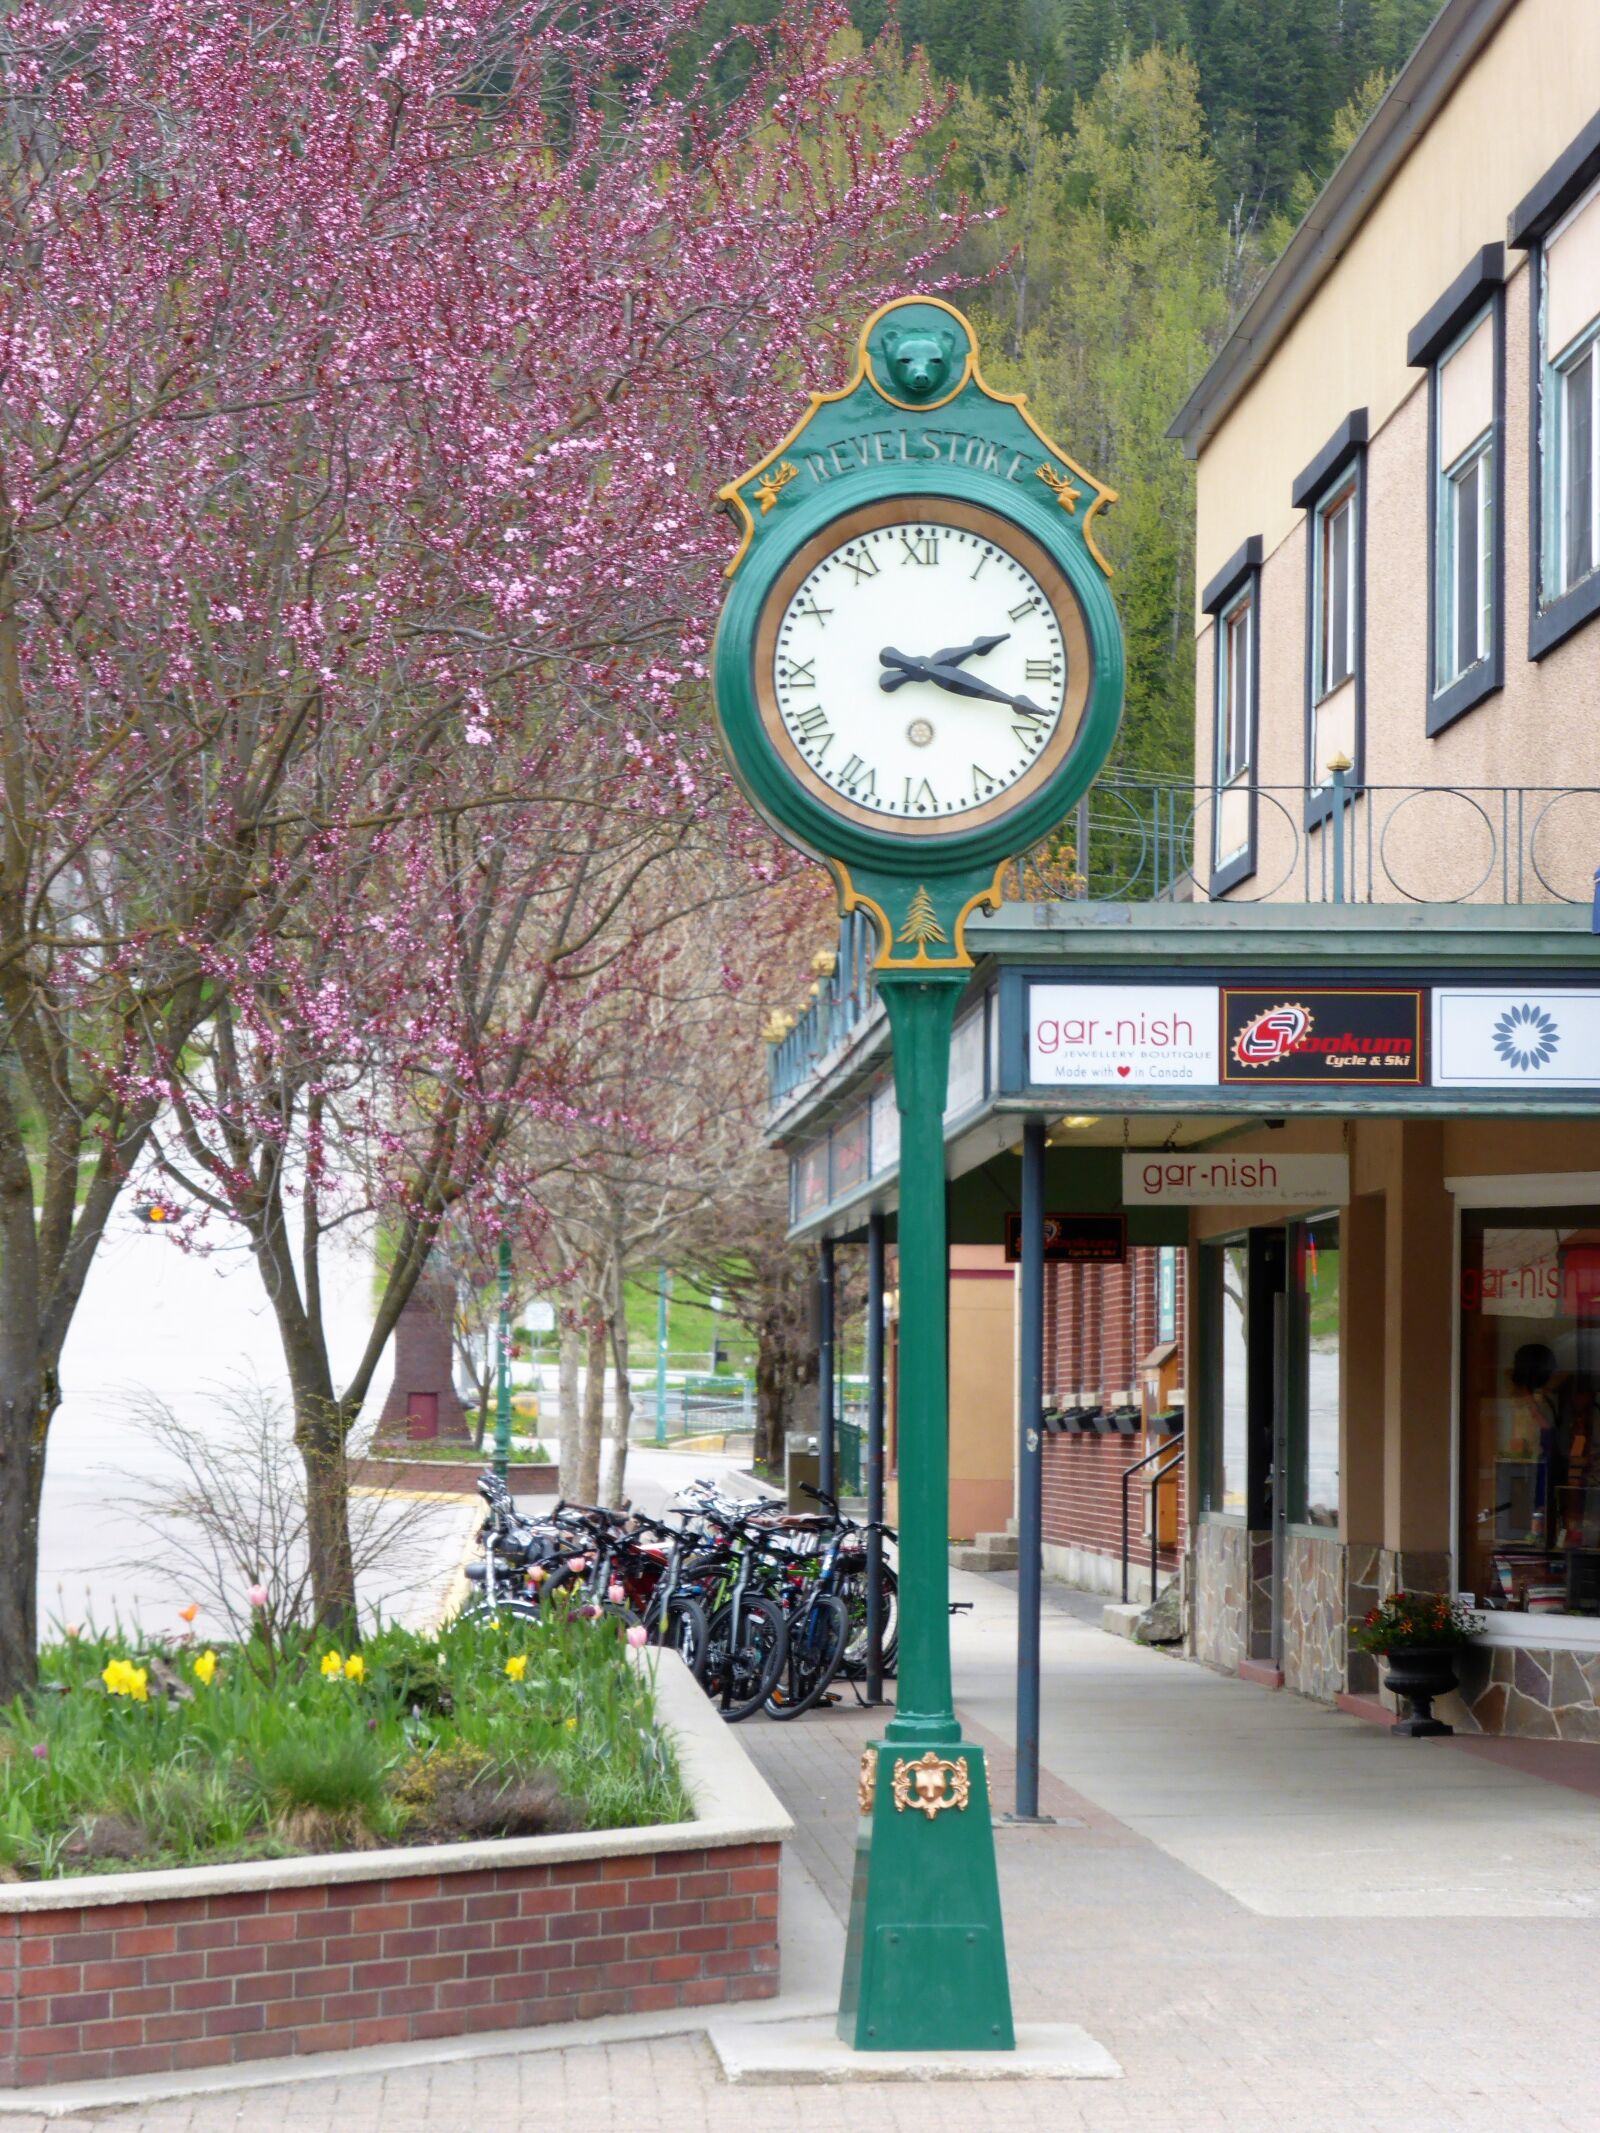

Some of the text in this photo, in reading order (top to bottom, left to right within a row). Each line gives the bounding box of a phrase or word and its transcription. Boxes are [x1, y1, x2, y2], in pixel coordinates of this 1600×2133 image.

[802, 429, 1033, 484] REVELSTOKE
[900, 538, 940, 565] XII
[1025, 658, 1053, 680] III
[1064, 1050, 1213, 1059] JEWELLERY BOUTIQUE
[1325, 1054, 1411, 1068] Cycle & Ski
[1055, 1065, 1193, 1078] Made with in Canada
